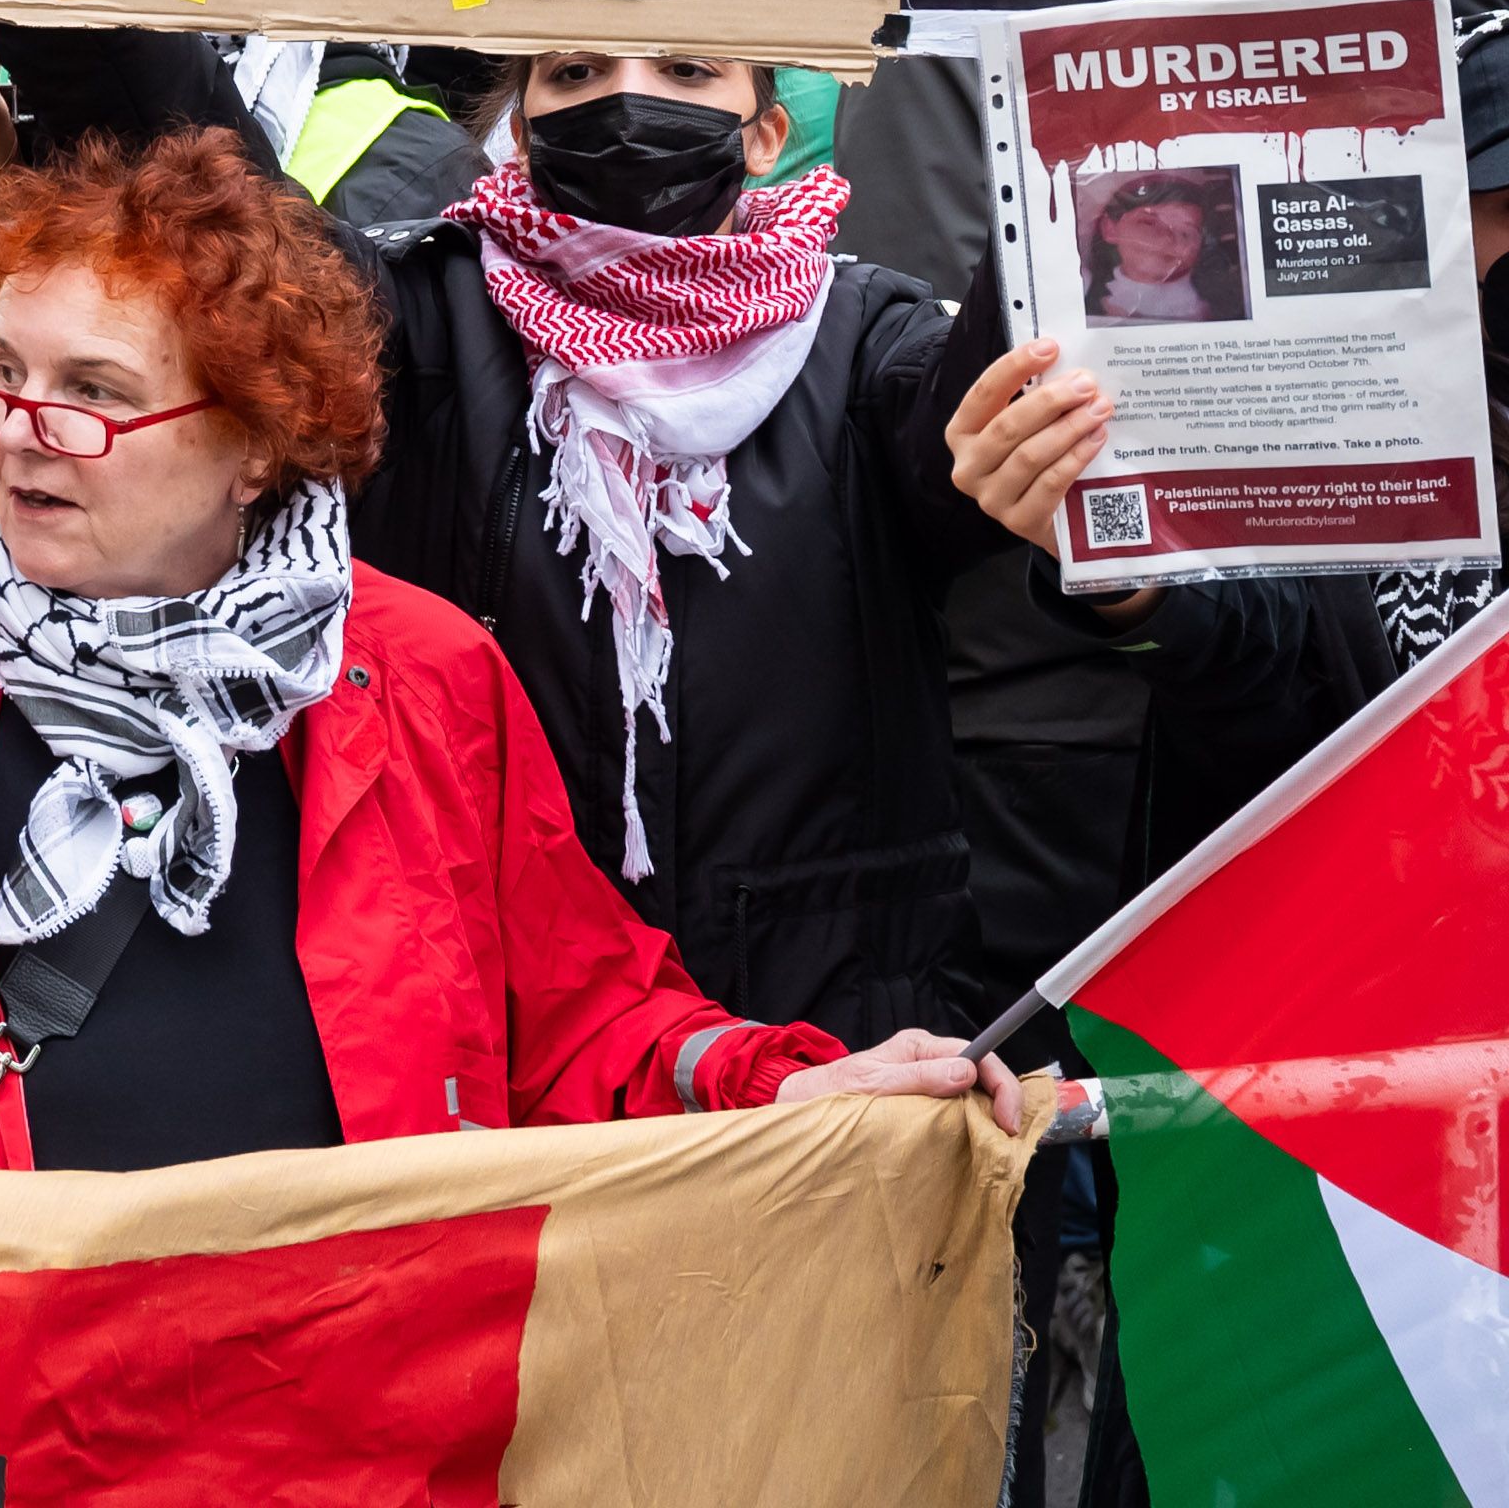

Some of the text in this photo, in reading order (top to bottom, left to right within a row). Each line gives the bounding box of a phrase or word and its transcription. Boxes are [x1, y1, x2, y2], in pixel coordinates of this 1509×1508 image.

[1053, 30, 1409, 92] MURDERED
[1160, 85, 1306, 112] BY ISRAEL
[1271, 195, 1355, 215] Isara Al-
[1273, 216, 1354, 233] Qassas,
[1275, 233, 1372, 253] 10 years old.
[1276, 254, 1361, 269] Murdered on 21
[1277, 270, 1329, 283] July 2014
[1114, 331, 1396, 355] Since its creation in 1948, Israel has committed the most
[1107, 358, 1152, 367] atrocious
[1155, 356, 1188, 365] crimes
[1206, 354, 1222, 362] the
[1226, 351, 1280, 362] Palestinian
[1282, 347, 1339, 360] population.
[1342, 345, 1384, 355] Murders
[1386, 342, 1406, 352] and
[1142, 367, 1190, 377] brutalities
[1192, 366, 1212, 375] that
[1215, 364, 1249, 373] extend
[1268, 360, 1305, 372] beyond
[1308, 358, 1350, 368] October
[1352, 357, 1372, 367] 7th.
[1120, 389, 1133, 398] As
[1135, 388, 1151, 397] the
[1154, 387, 1181, 396] world
[1221, 384, 1263, 393] watches
[1275, 379, 1328, 392] systematic
[1331, 377, 1381, 390] genocide,
[1384, 377, 1399, 385] we
[1114, 401, 1129, 410] will
[1132, 398, 1175, 409] continue
[1177, 398, 1188, 407] to
[1190, 397, 1214, 406] raise
[1217, 397, 1232, 405] our
[1236, 395, 1268, 404] voices
[1271, 394, 1290, 403] and
[1293, 394, 1309, 402] our
[1312, 392, 1346, 401] stories
[1356, 390, 1367, 399] of
[1369, 389, 1407, 399] murder,
[1159, 410, 1200, 421] targeted
[1203, 408, 1239, 418] attacks
[1241, 407, 1252, 416] of
[1254, 405, 1297, 416] civilians,
[1300, 404, 1319, 413] and
[1321, 403, 1338, 412] the
[1341, 402, 1364, 414] grim
[1366, 400, 1396, 411] reality
[1399, 399, 1409, 408] of
[1186, 415, 1337, 430] ruthless and bloody apartheid.
[1114, 436, 1423, 460] Spread the truth. Change the narrative. Take a photo.
[1154, 476, 1451, 500] Palestinians have every right to their land.
[1169, 492, 1439, 513] Palestinians have every right to resist.
[1245, 514, 1356, 528] #MurderedbyIsrael
